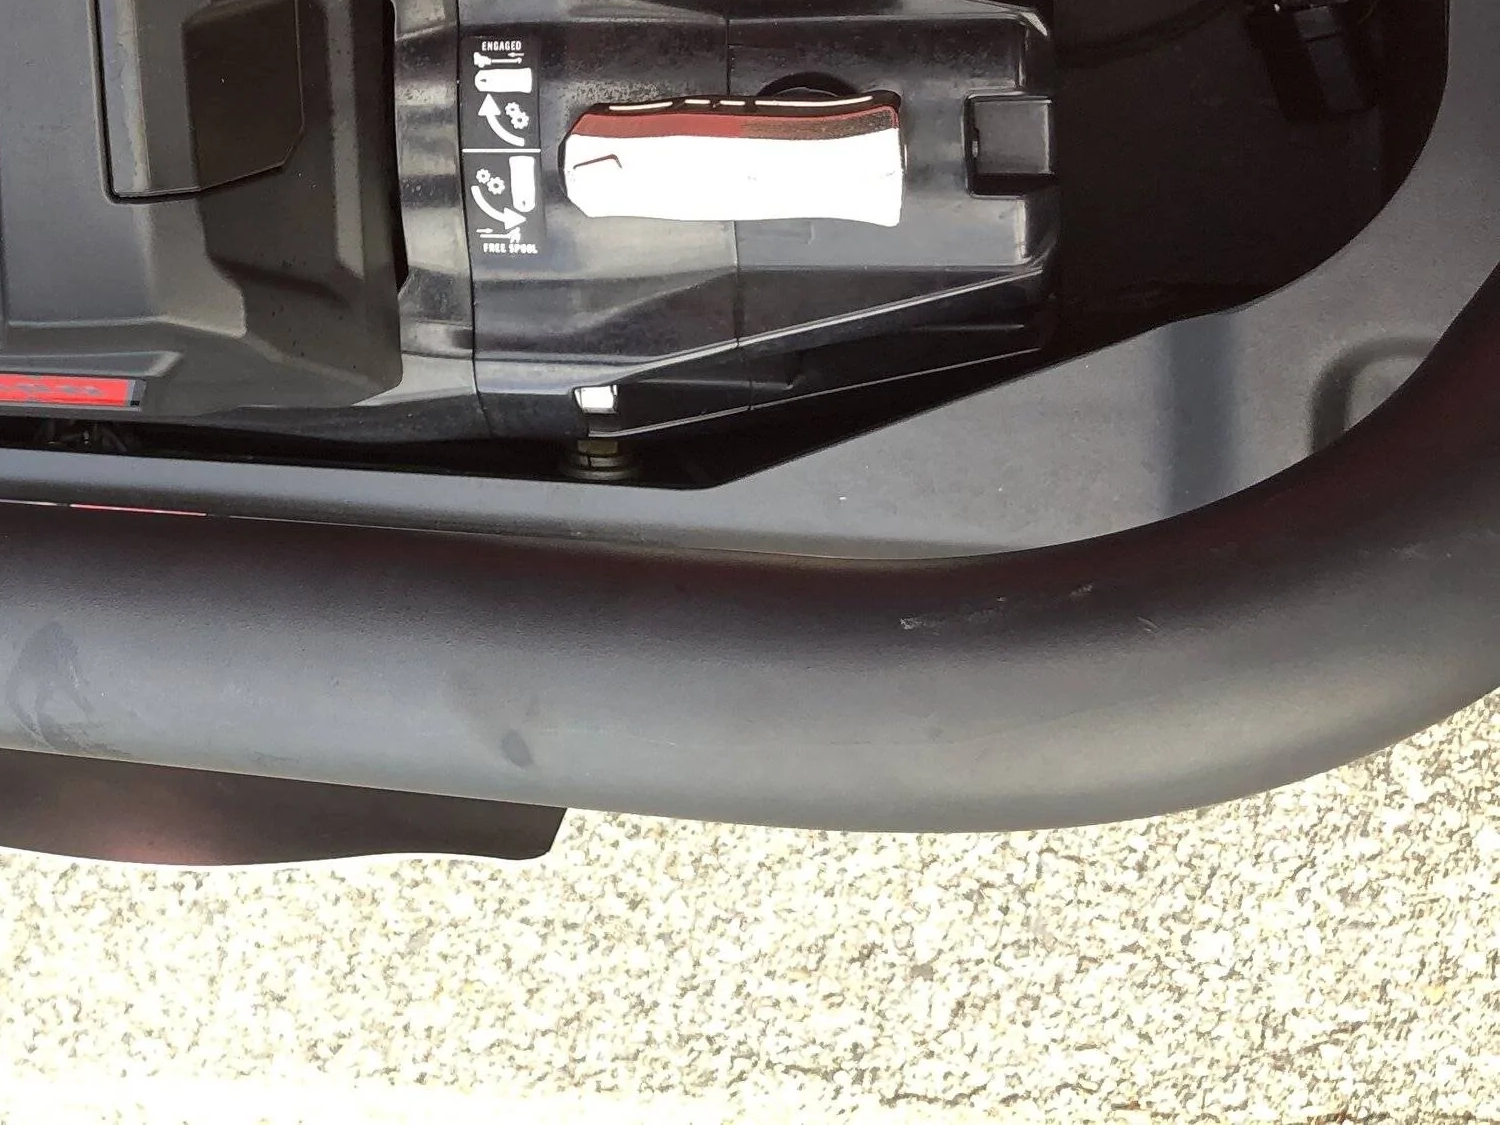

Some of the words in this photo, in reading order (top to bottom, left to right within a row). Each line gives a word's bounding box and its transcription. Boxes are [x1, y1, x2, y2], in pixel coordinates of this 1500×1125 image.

[481, 40, 522, 51] ENGAGED
[483, 242, 506, 253] FREE
[508, 243, 538, 254] SPOOL
